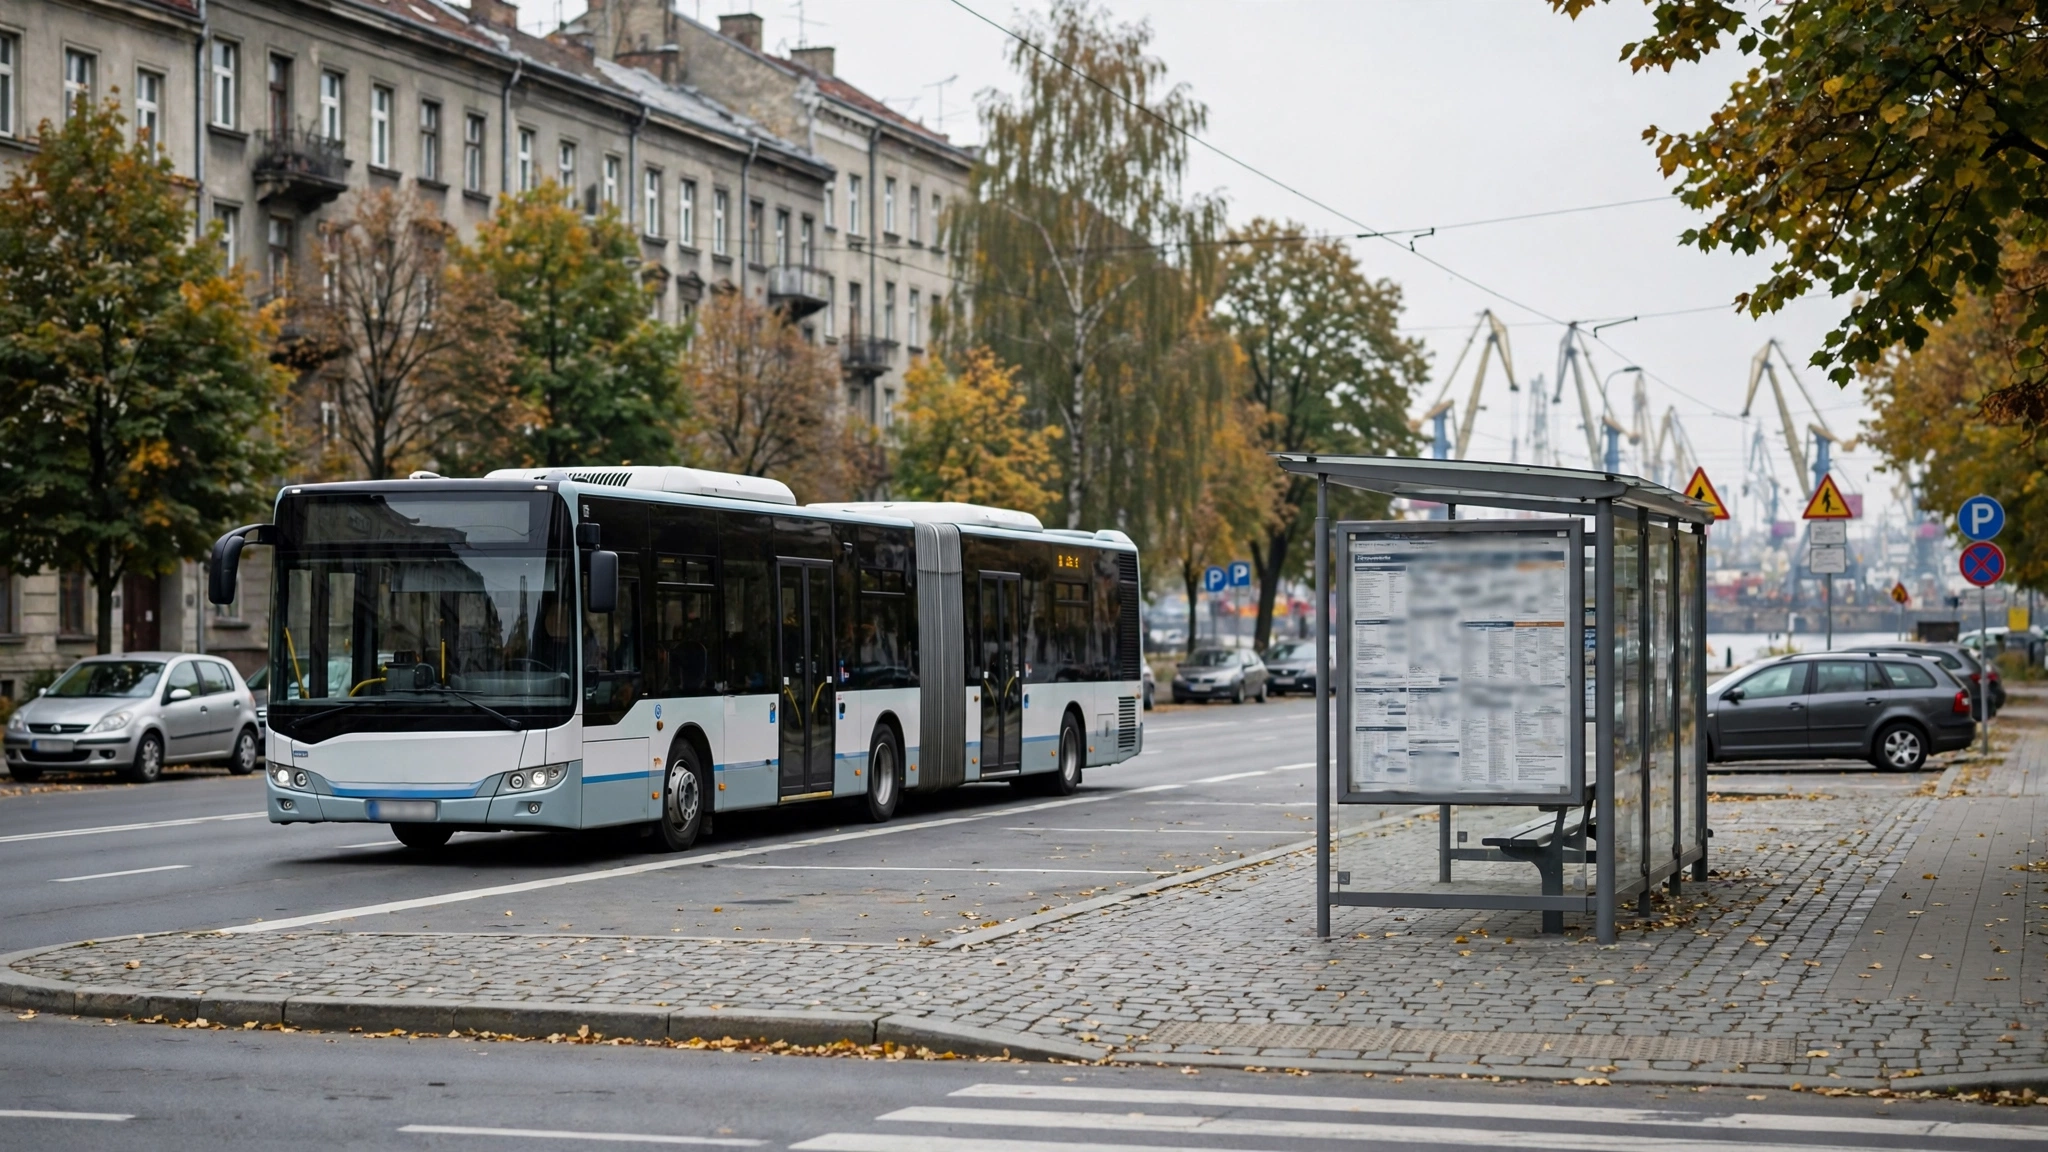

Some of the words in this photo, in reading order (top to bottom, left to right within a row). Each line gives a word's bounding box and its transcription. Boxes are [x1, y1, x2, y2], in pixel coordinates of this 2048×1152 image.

[1971, 503, 1995, 534] P
[1209, 569, 1223, 590] P
[1233, 564, 1248, 584] P
